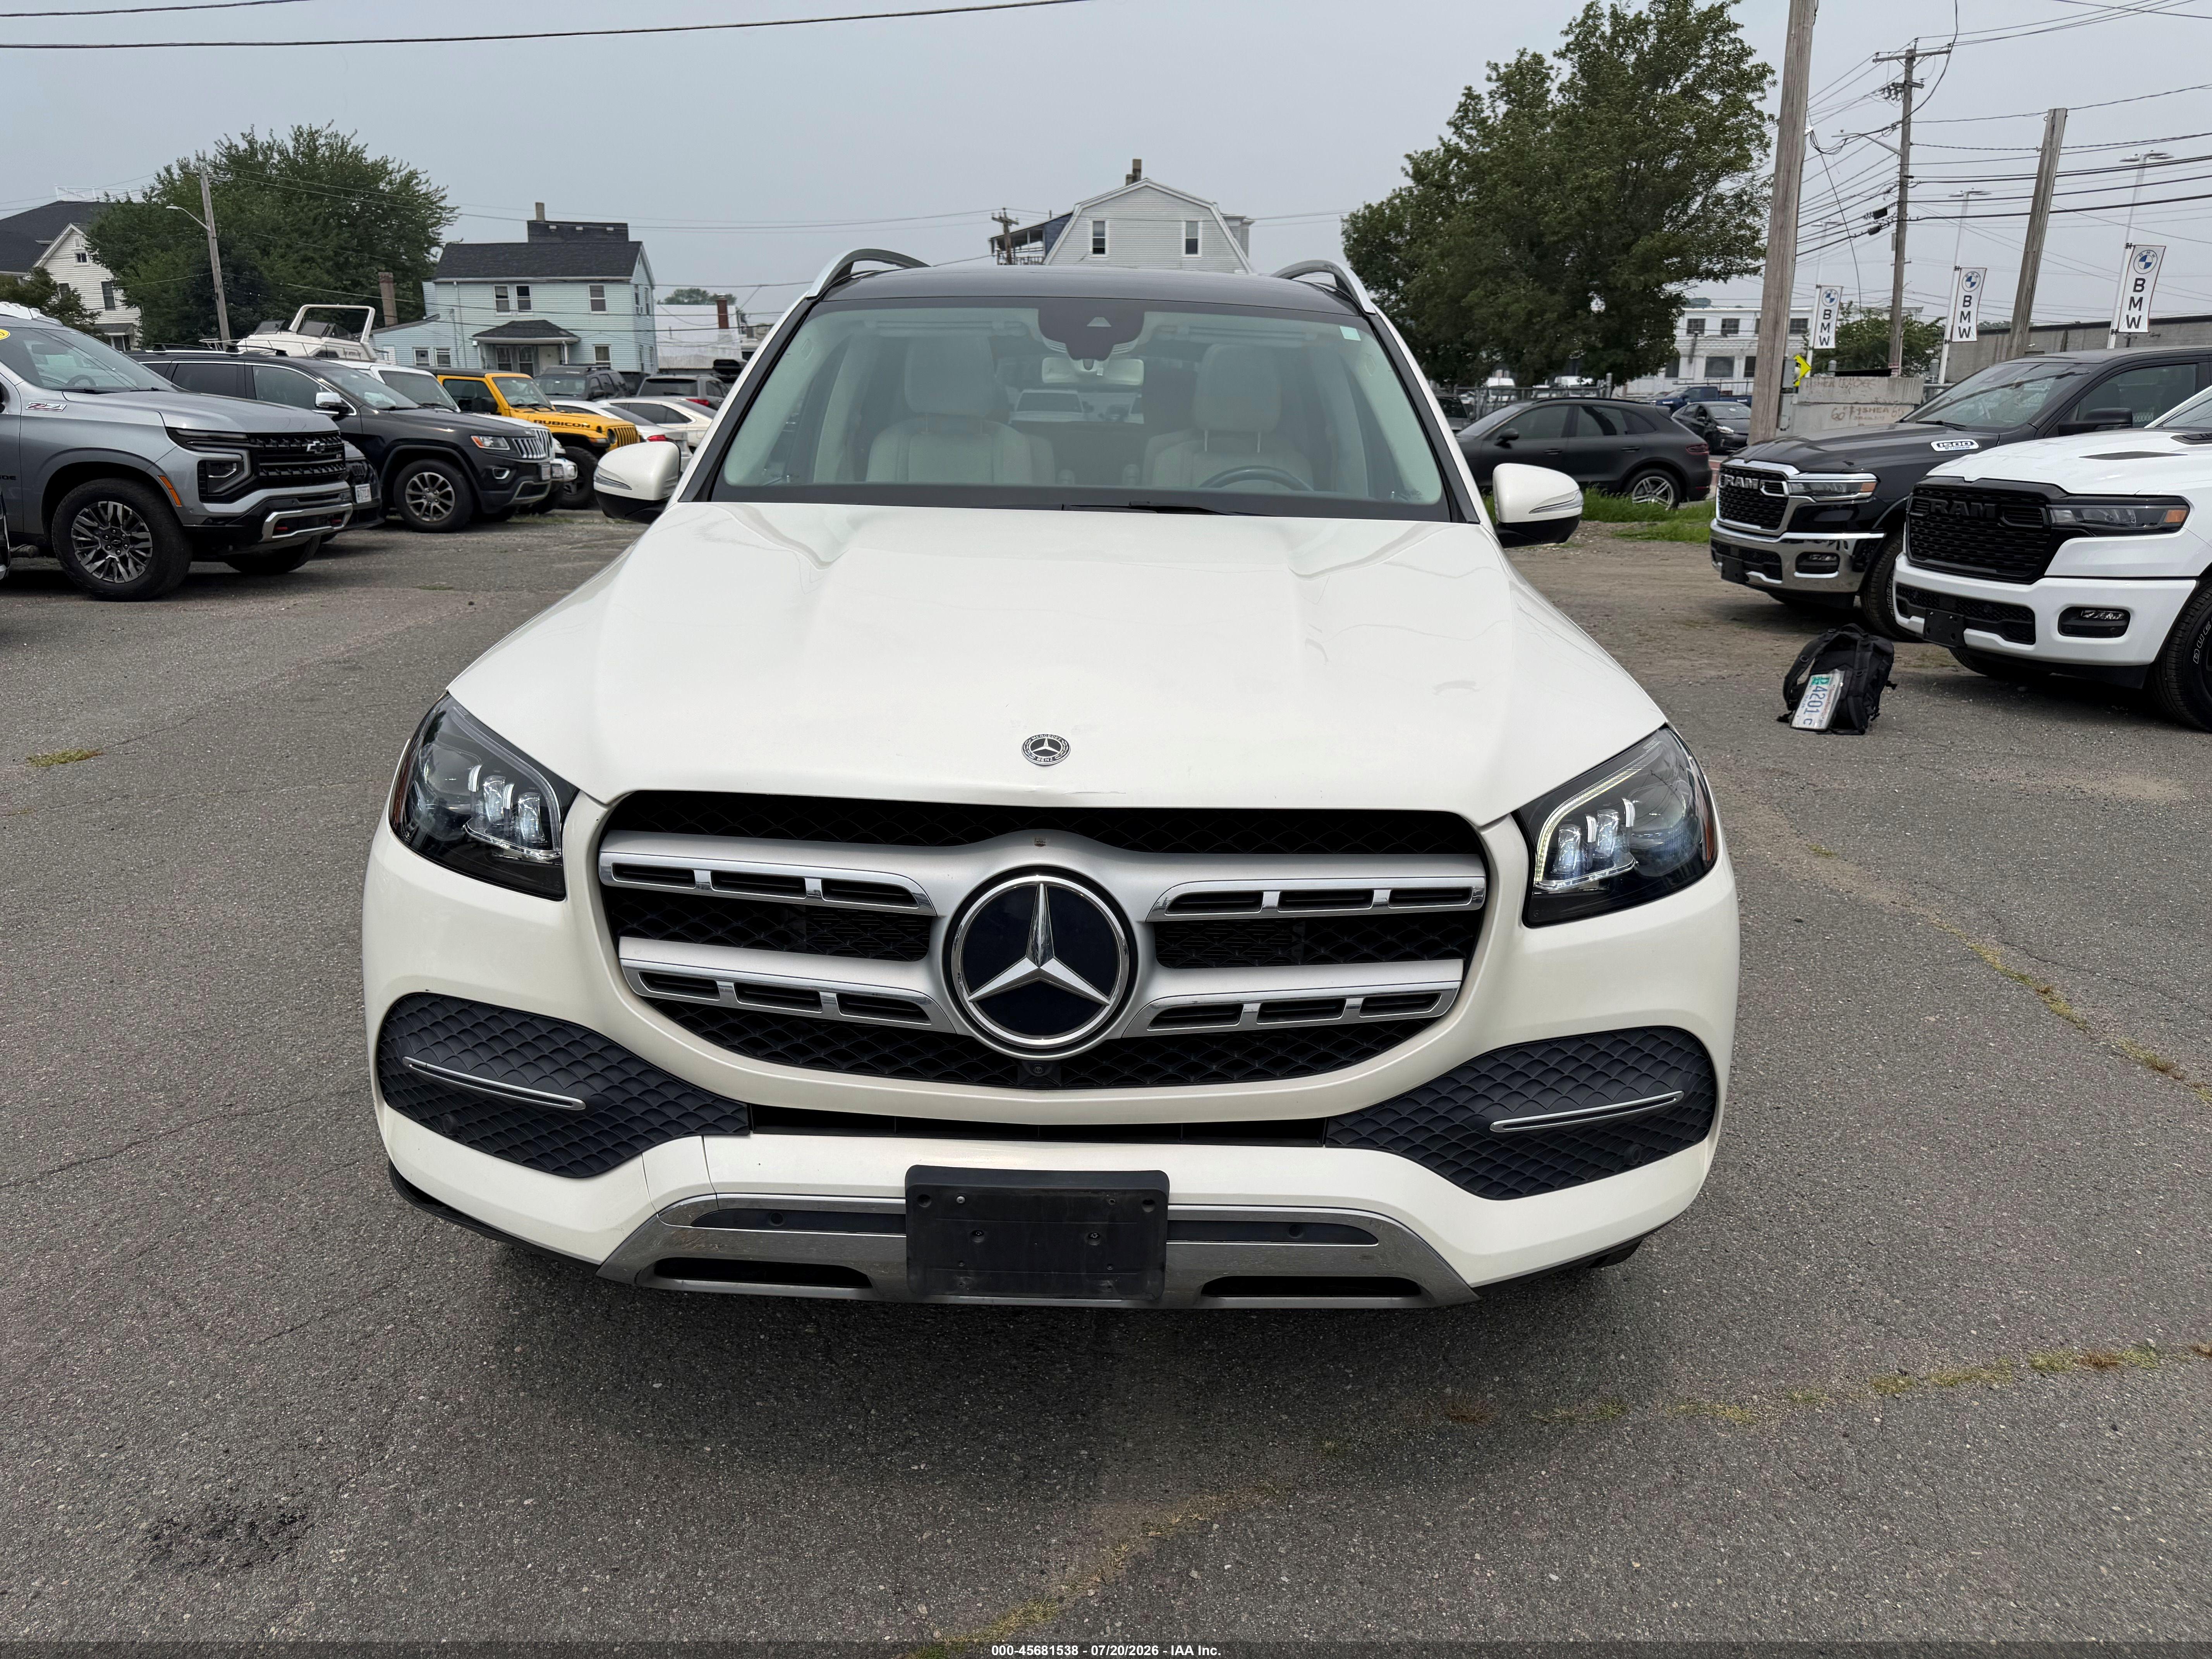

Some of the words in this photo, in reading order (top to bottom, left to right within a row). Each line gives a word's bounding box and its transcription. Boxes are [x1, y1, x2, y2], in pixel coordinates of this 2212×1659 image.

[1958, 295, 1972, 338] BMW
[2126, 278, 2146, 329] BMW
[1819, 309, 1832, 346] BMW
[534, 420, 591, 428] RUBICON
[1724, 474, 1759, 489] RAM
[1930, 499, 1996, 518] RAM
[1803, 685, 1828, 714] 4201
